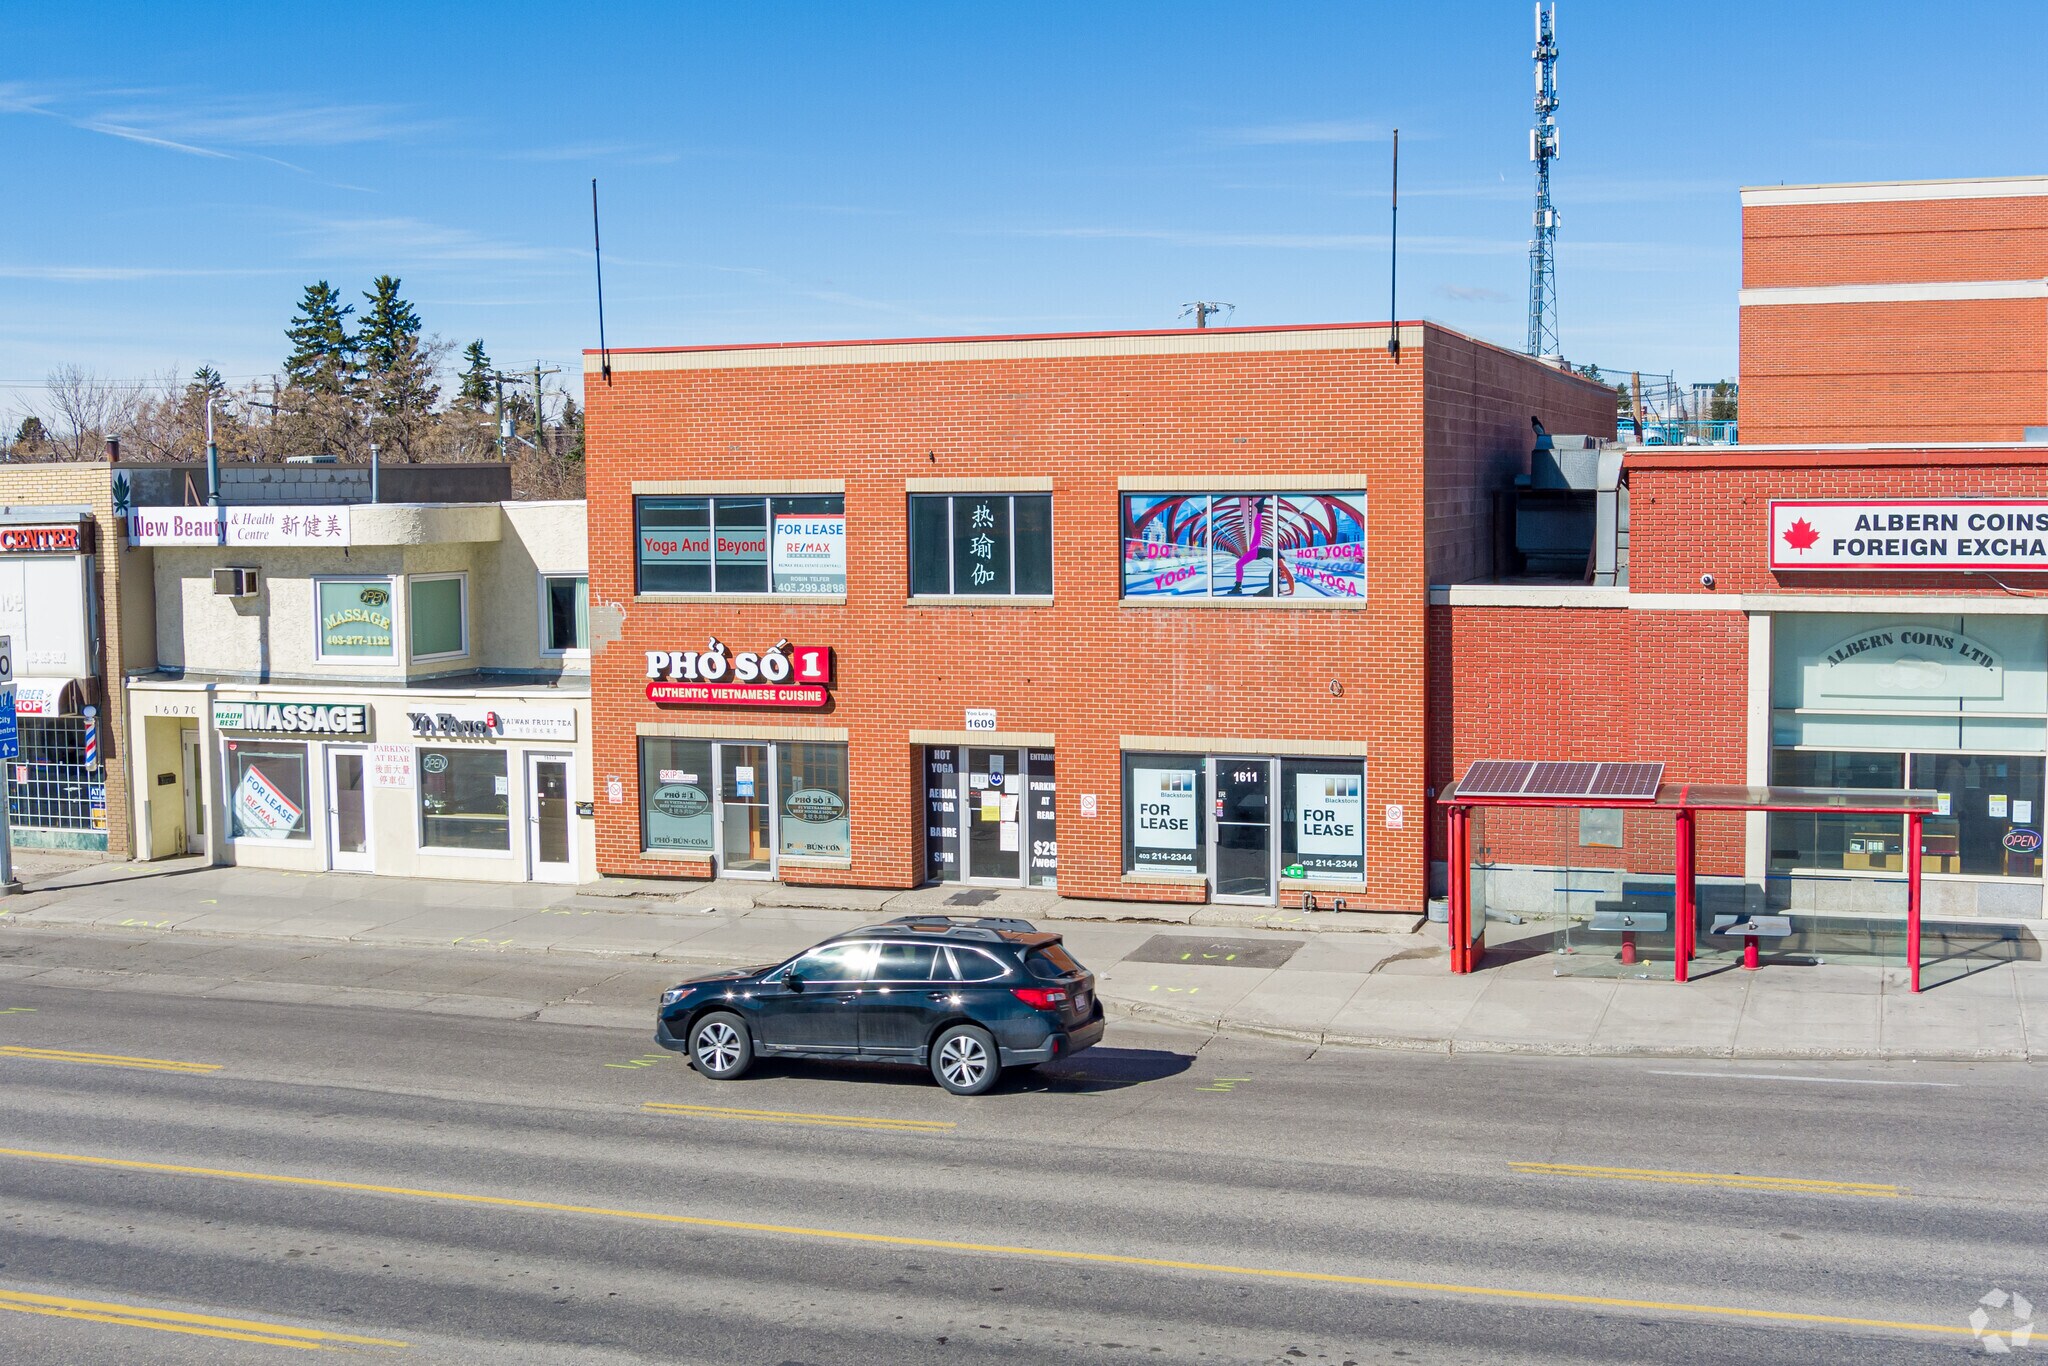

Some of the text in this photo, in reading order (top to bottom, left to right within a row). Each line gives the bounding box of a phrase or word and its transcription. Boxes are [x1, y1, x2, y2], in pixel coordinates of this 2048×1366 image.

[231, 513, 275, 525] & Health
[1854, 513, 2048, 532] ALBERN COINS
[133, 515, 228, 542] New Beauty
[281, 514, 342, 538] 新健美
[777, 524, 844, 535] FOR LEASE
[0, 528, 78, 549] CENTER
[237, 527, 270, 540] Centre
[644, 537, 766, 555] Yoga And Beyond
[786, 543, 831, 552] RE/MAX
[969, 504, 995, 586] 热瑜伽
[1832, 538, 2047, 556] FOREIGN EXCHA
[1147, 543, 1170, 560] DO
[1296, 544, 1363, 559] HOT YOGA
[1153, 564, 1197, 590] YOGA
[1295, 563, 1357, 597] YIN YOGA
[777, 583, 845, 593] 403.299.8888
[324, 609, 391, 631] MASSAGE
[1826, 631, 1994, 672] ALBERN COINS LTD.
[802, 652, 821, 676] 1
[651, 687, 822, 701] AUTHENTIC VIETNAMESE CUISINE
[215, 712, 242, 720] HEALTH
[247, 704, 365, 732] MASSAGE
[502, 718, 530, 726] TAIWAN
[219, 719, 239, 727] BEST
[968, 719, 995, 729] 1609
[373, 744, 411, 753] PARKING
[387, 755, 410, 763] REAR
[934, 750, 951, 760] HOT
[424, 758, 447, 769] OPEN
[931, 763, 954, 773] YOGA
[660, 770, 677, 779] SKIP
[1233, 771, 1258, 783] 1611
[246, 776, 266, 797] FOR
[929, 788, 957, 799] AERIAL
[932, 802, 955, 812] YOGA
[1041, 797, 1051, 806] AT
[245, 795, 278, 828] RE/MAX
[264, 793, 294, 824] LEASE
[1140, 804, 1171, 816] FOR
[1036, 811, 1055, 820] REAR
[1303, 809, 1335, 822] FOR
[1140, 818, 1189, 830] LEASE
[1304, 823, 1354, 836] LEASE
[930, 827, 957, 837] BARRE
[2004, 835, 2038, 847] OPEN
[934, 852, 954, 862] SPIN
[1152, 853, 1193, 861] 214-2344
[1316, 859, 1358, 868] 214-2344
